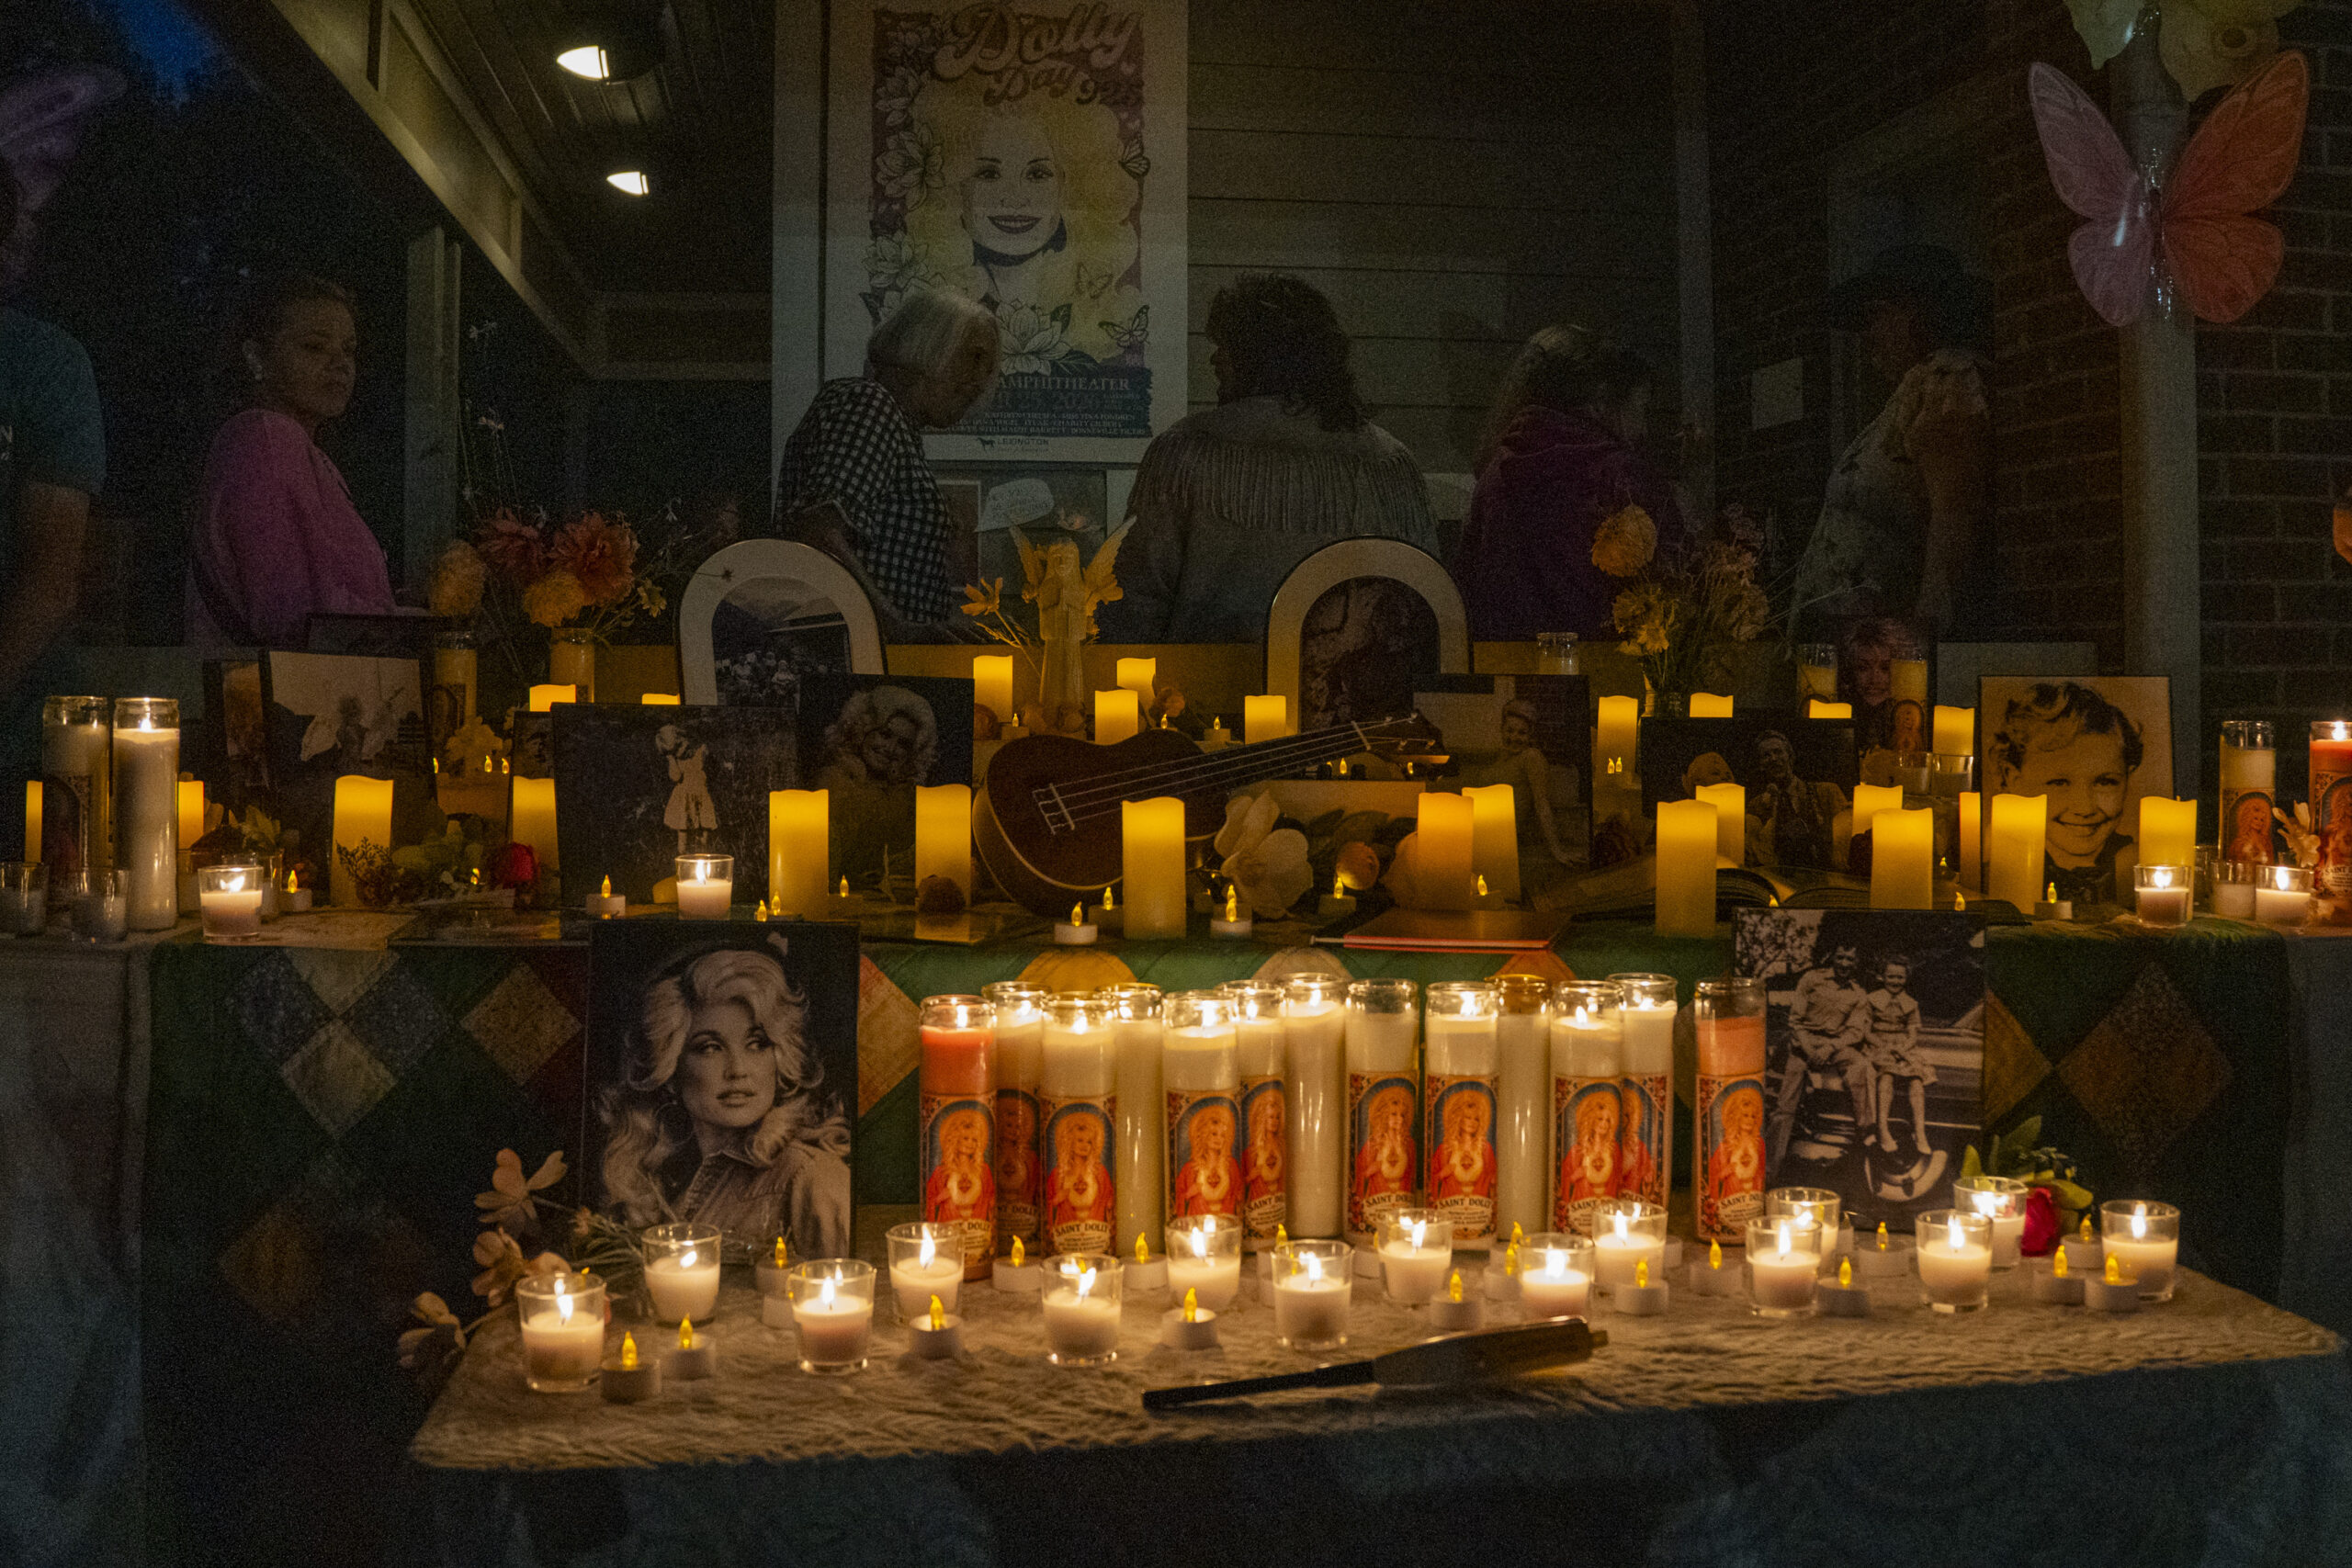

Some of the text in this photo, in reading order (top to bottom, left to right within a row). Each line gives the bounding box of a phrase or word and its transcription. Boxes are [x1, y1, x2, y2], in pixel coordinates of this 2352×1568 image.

[931, 2, 1143, 83] Dolly
[998, 377, 1129, 390] AMPHITHEATER
[998, 437, 1049, 446] LEXINGTON
[1247, 1197, 1272, 1211] SAINT
[1365, 1193, 1392, 1206] SAINT
[1437, 1197, 1465, 1210] SAINT
[1569, 1198, 1597, 1213] SAINT
[1721, 1194, 1746, 1208] SAINT
[1056, 1224, 1080, 1236] SAINT
